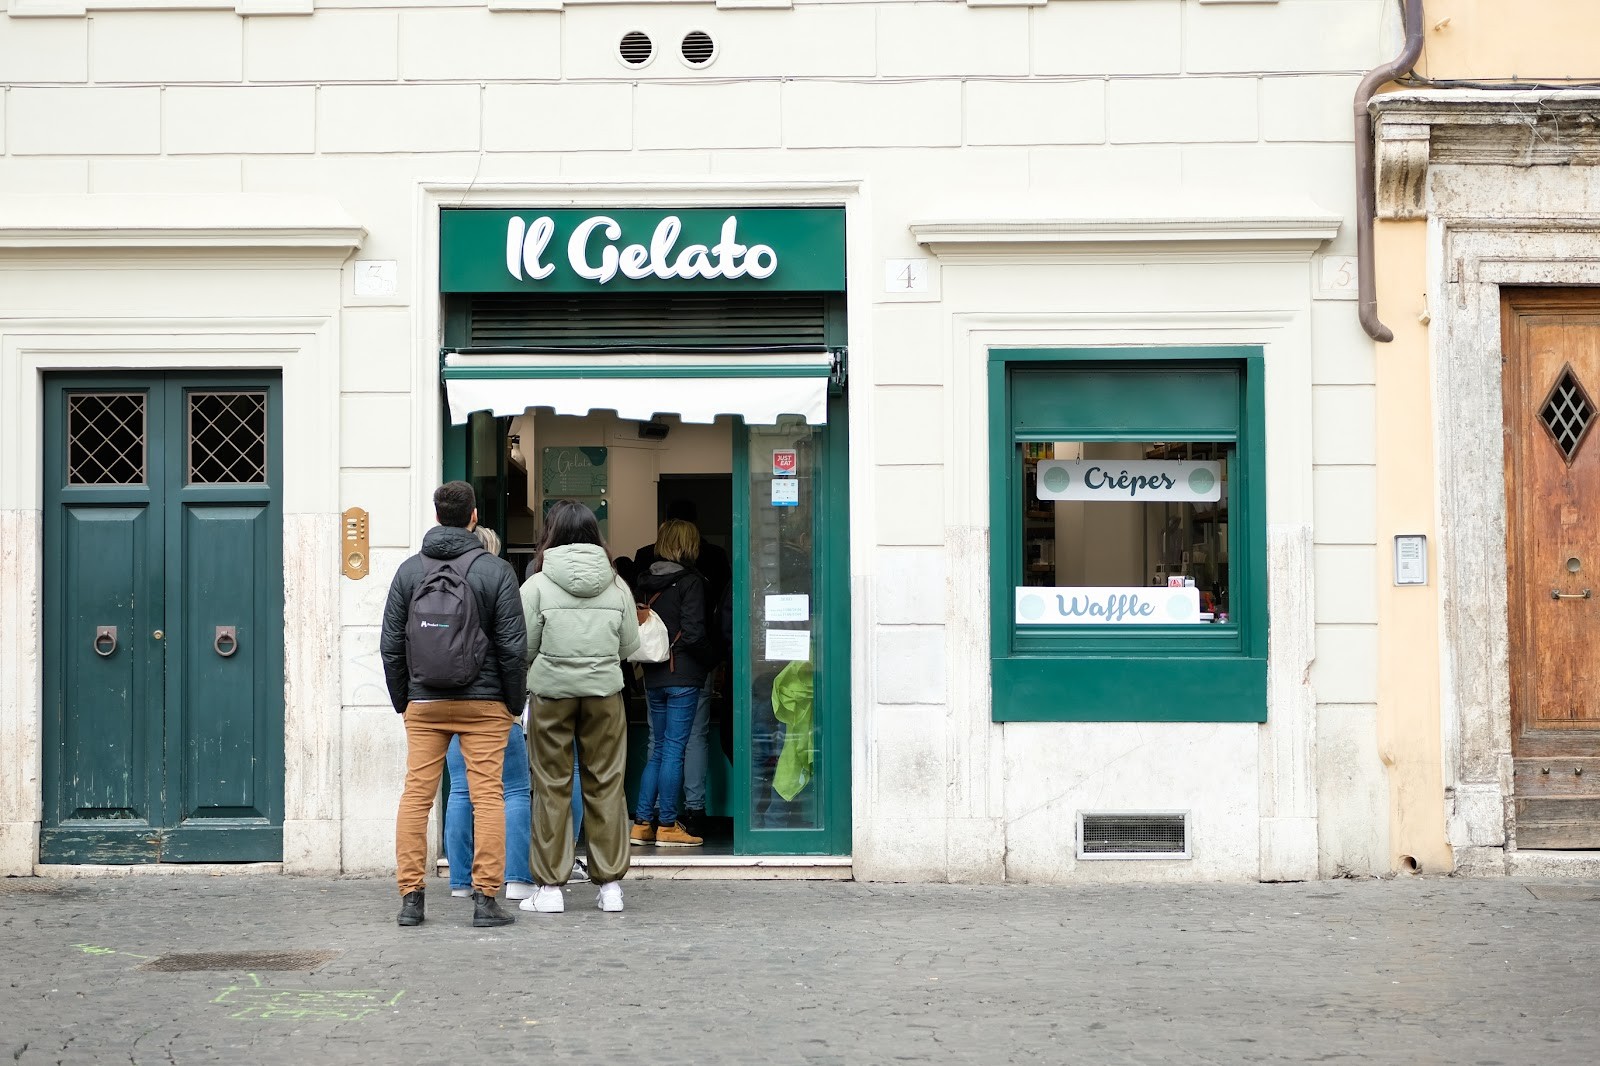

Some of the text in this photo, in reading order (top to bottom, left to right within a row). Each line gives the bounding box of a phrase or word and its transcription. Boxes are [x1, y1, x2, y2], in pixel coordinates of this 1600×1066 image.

[506, 215, 778, 285] Il Gelato
[896, 263, 917, 289] 4
[1337, 260, 1353, 287] 5
[1084, 466, 1177, 497] Crêpes
[1055, 593, 1156, 622] Waffle
